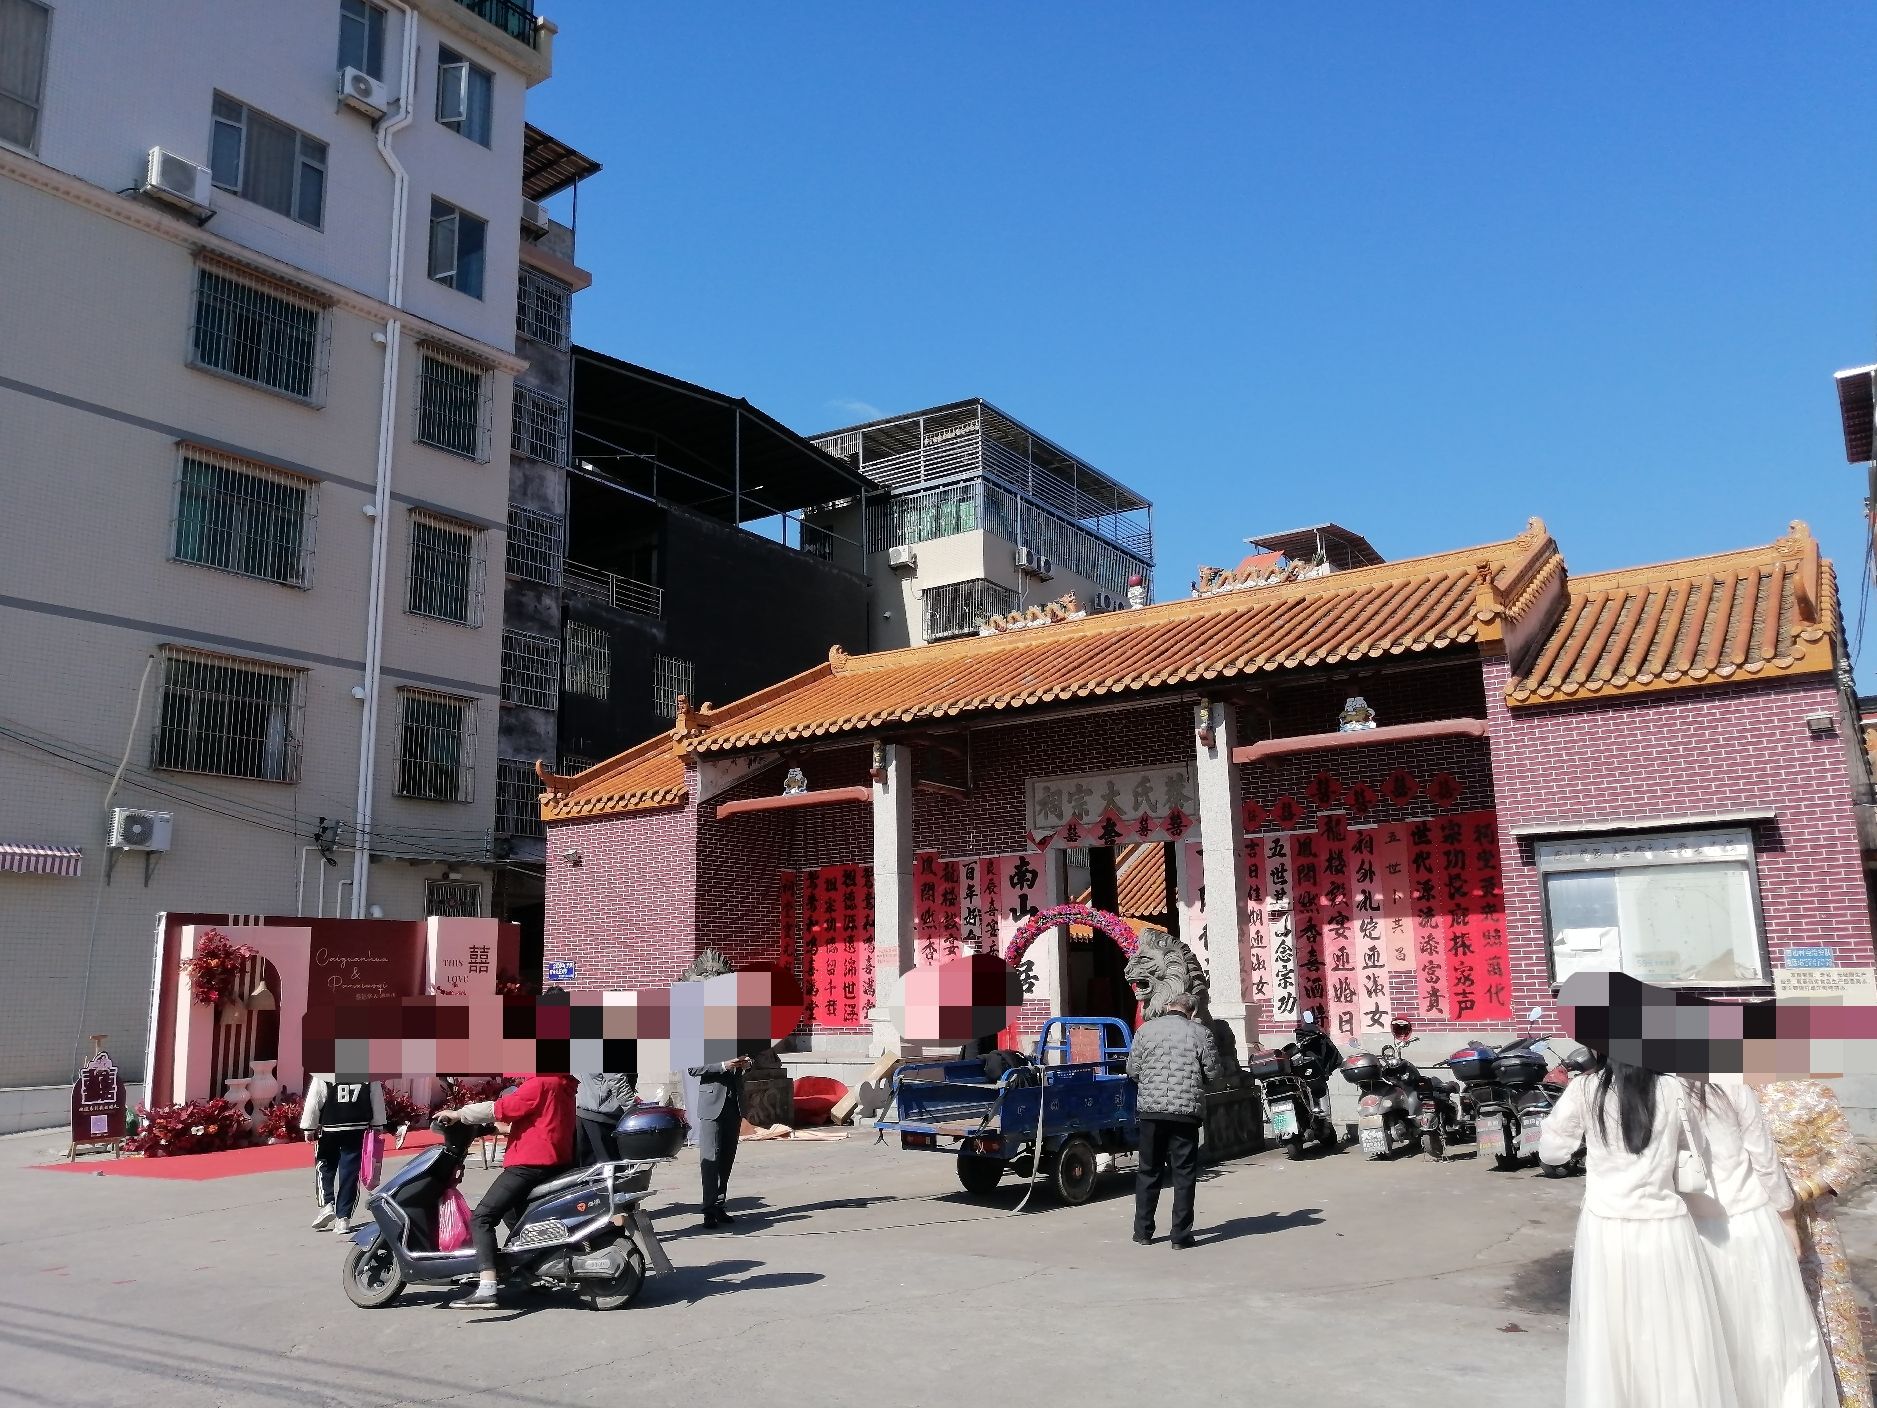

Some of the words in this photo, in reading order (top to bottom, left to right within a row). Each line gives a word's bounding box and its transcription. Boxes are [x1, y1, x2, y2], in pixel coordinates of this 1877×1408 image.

[443, 959, 463, 967] THIS
[468, 945, 490, 974] 囍
[337, 1084, 362, 1103] 87
